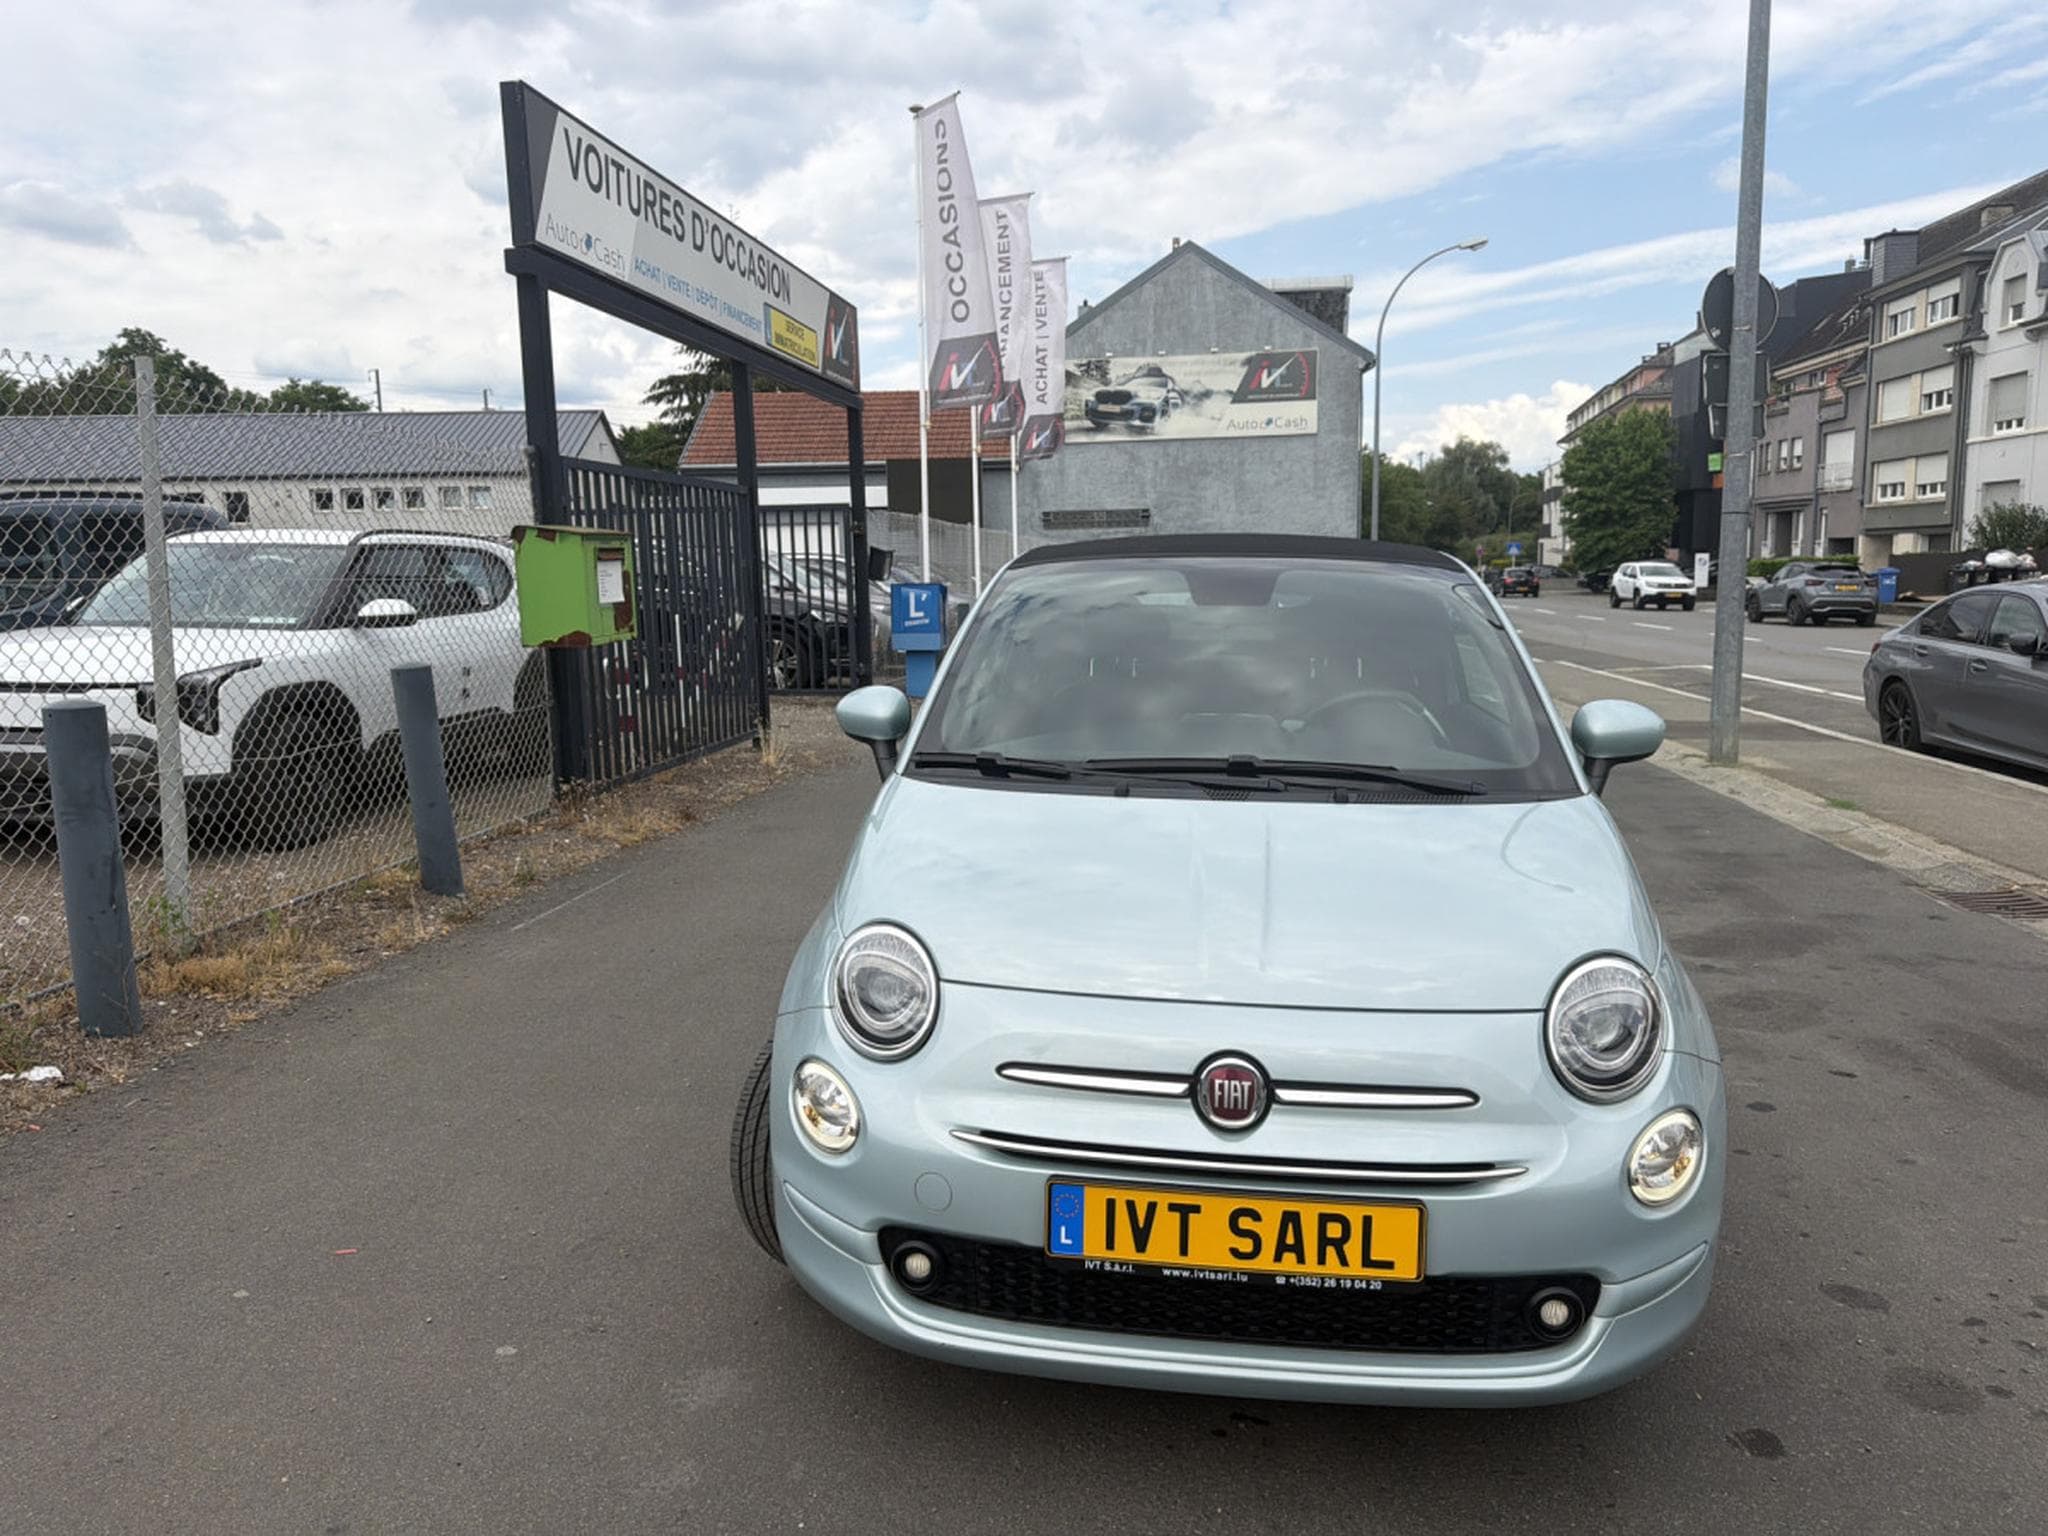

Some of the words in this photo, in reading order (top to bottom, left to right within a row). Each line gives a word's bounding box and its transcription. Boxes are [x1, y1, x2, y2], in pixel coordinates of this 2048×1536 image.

[546, 213, 578, 250] Auto
[594, 237, 625, 272] Cash
[563, 127, 685, 242] VOITURES
[692, 210, 791, 304] D'OCCASION
[1034, 271, 1048, 330] VENTE
[1035, 346, 1048, 405] ACHAT
[1226, 419, 1258, 431] Auto
[1274, 415, 1308, 428] Cash
[1214, 1079, 1252, 1110] FIAT
[1061, 1226, 1073, 1245] L
[1105, 1198, 1202, 1257] IVT
[1228, 1208, 1395, 1270] SARL
[1084, 1259, 1101, 1270] IVT
[1162, 1268, 1248, 1282] www.ivtsarl.lu
[1369, 1280, 1382, 1290] 20
